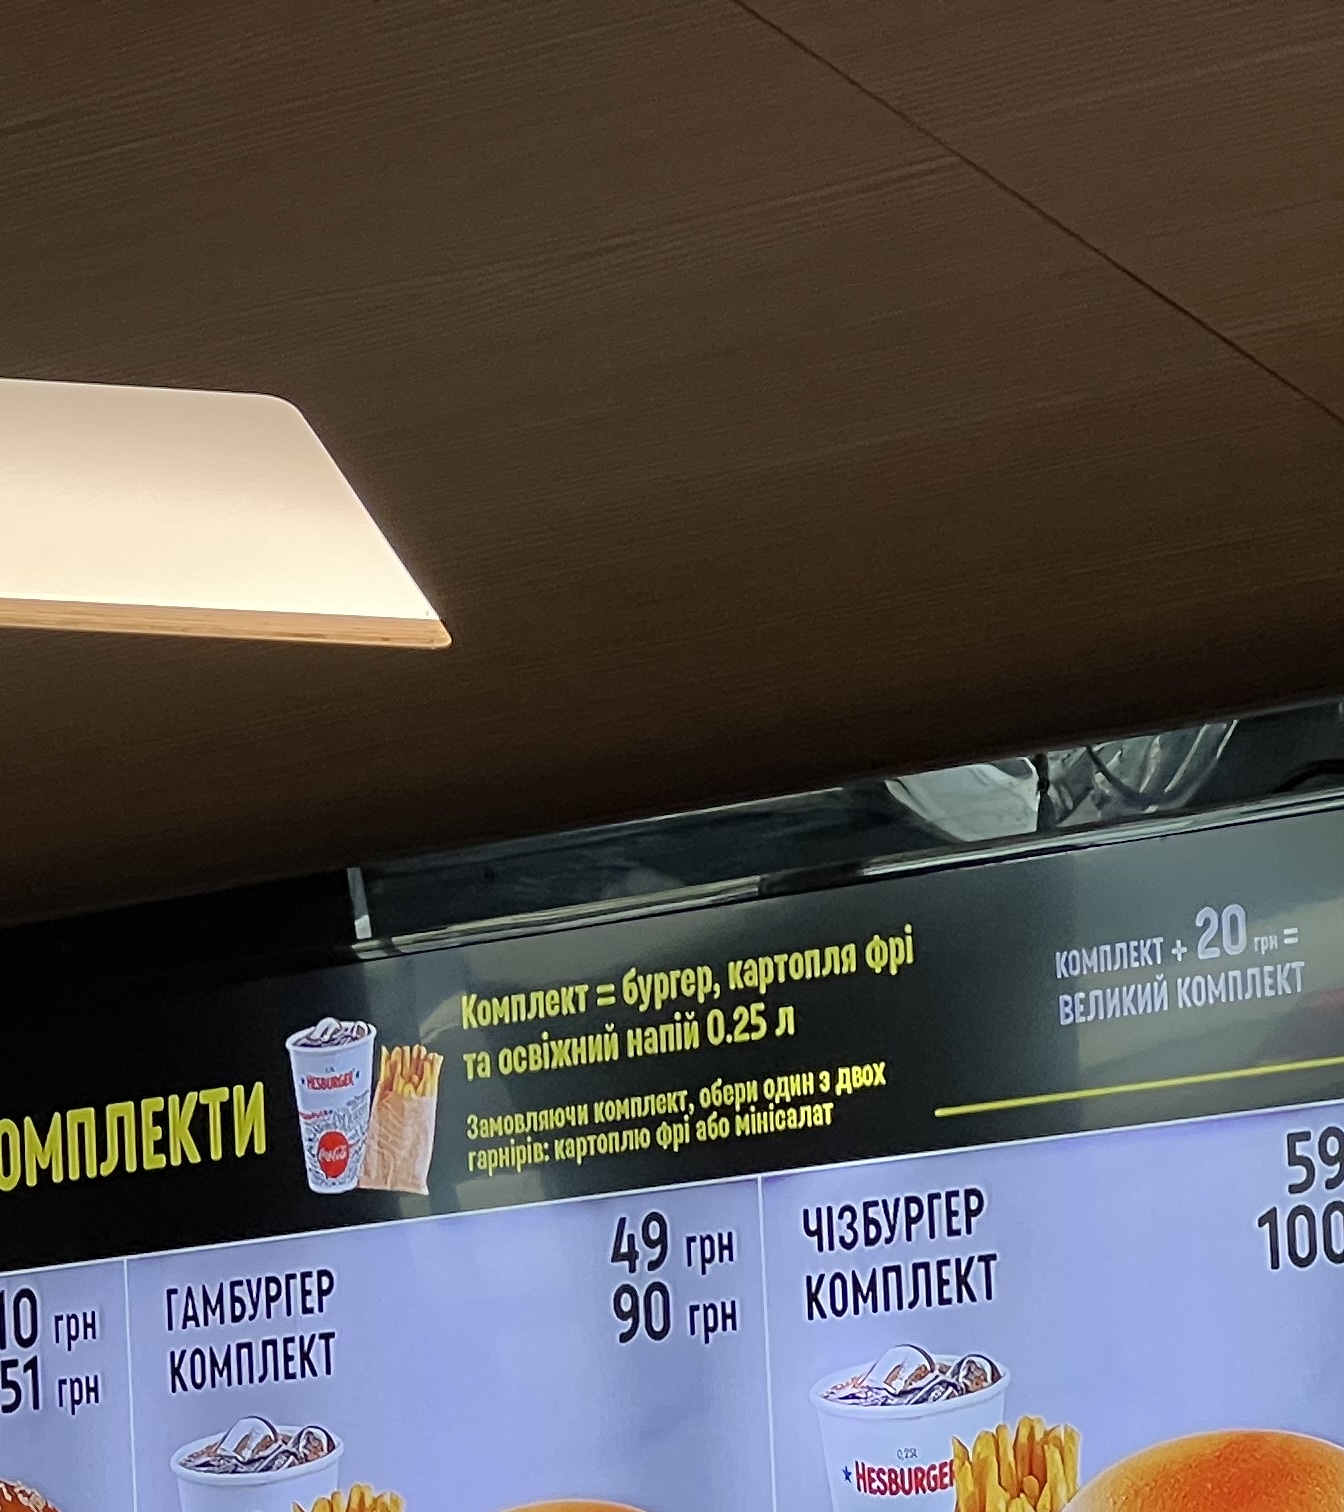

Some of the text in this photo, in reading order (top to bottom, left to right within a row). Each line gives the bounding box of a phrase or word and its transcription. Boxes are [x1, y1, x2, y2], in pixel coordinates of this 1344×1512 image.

[1055, 936, 1165, 982] КОМПЛЕКТ
[1195, 903, 1247, 961] 20
[460, 984, 589, 1031] Комплект
[622, 965, 721, 1013] бургер,
[727, 942, 857, 995] картопля
[865, 923, 914, 976] фрі
[1059, 961, 1305, 1026] ВЕЛИКИЙ КОМПЛЕКТ
[462, 1001, 795, 1082] та освіжний напій 0.25 л
[466, 1103, 589, 1143] Замовляючи
[593, 1089, 695, 1124] комплект,
[699, 1077, 759, 1113] обери
[763, 1071, 815, 1111] один
[835, 1061, 887, 1096] двох
[468, 1102, 834, 1178] гарнірів: картоплю фрі або мінісалат
[610, 1211, 734, 1276] 49 грн
[802, 1187, 985, 1253] ЧІЗБУРГЕР
[166, 1269, 335, 1332] ГАМБУРГЕР
[613, 1281, 737, 1345] 90 грн
[805, 1253, 998, 1321] КОМПЛЕКТ
[54, 1310, 97, 1352] грн
[169, 1331, 336, 1394] КОМПЛЕКТ
[57, 1374, 100, 1416] грн
